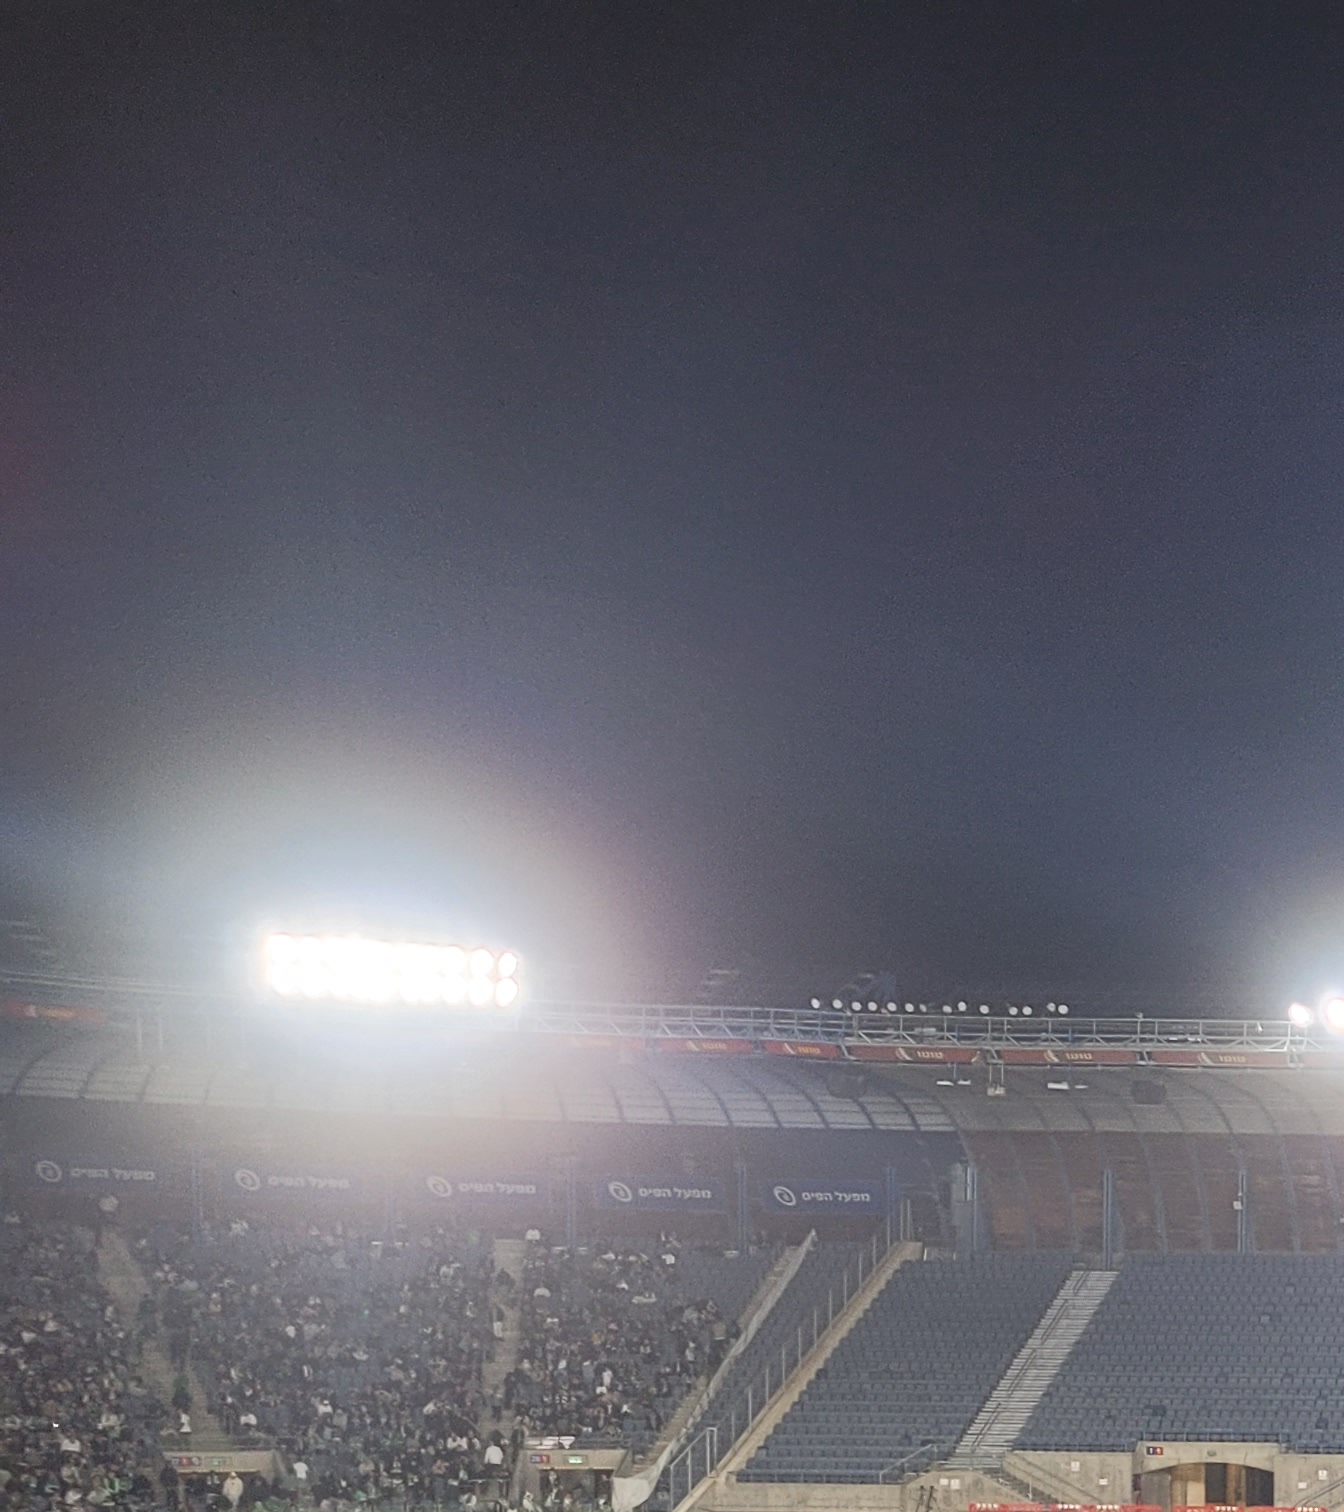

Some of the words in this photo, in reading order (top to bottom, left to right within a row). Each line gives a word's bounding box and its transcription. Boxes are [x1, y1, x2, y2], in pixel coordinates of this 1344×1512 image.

[638, 1187, 672, 1198] הפיס
[673, 1187, 712, 1200] מפעל
[802, 1190, 833, 1202] הפיס
[834, 1191, 871, 1203] מפעל
